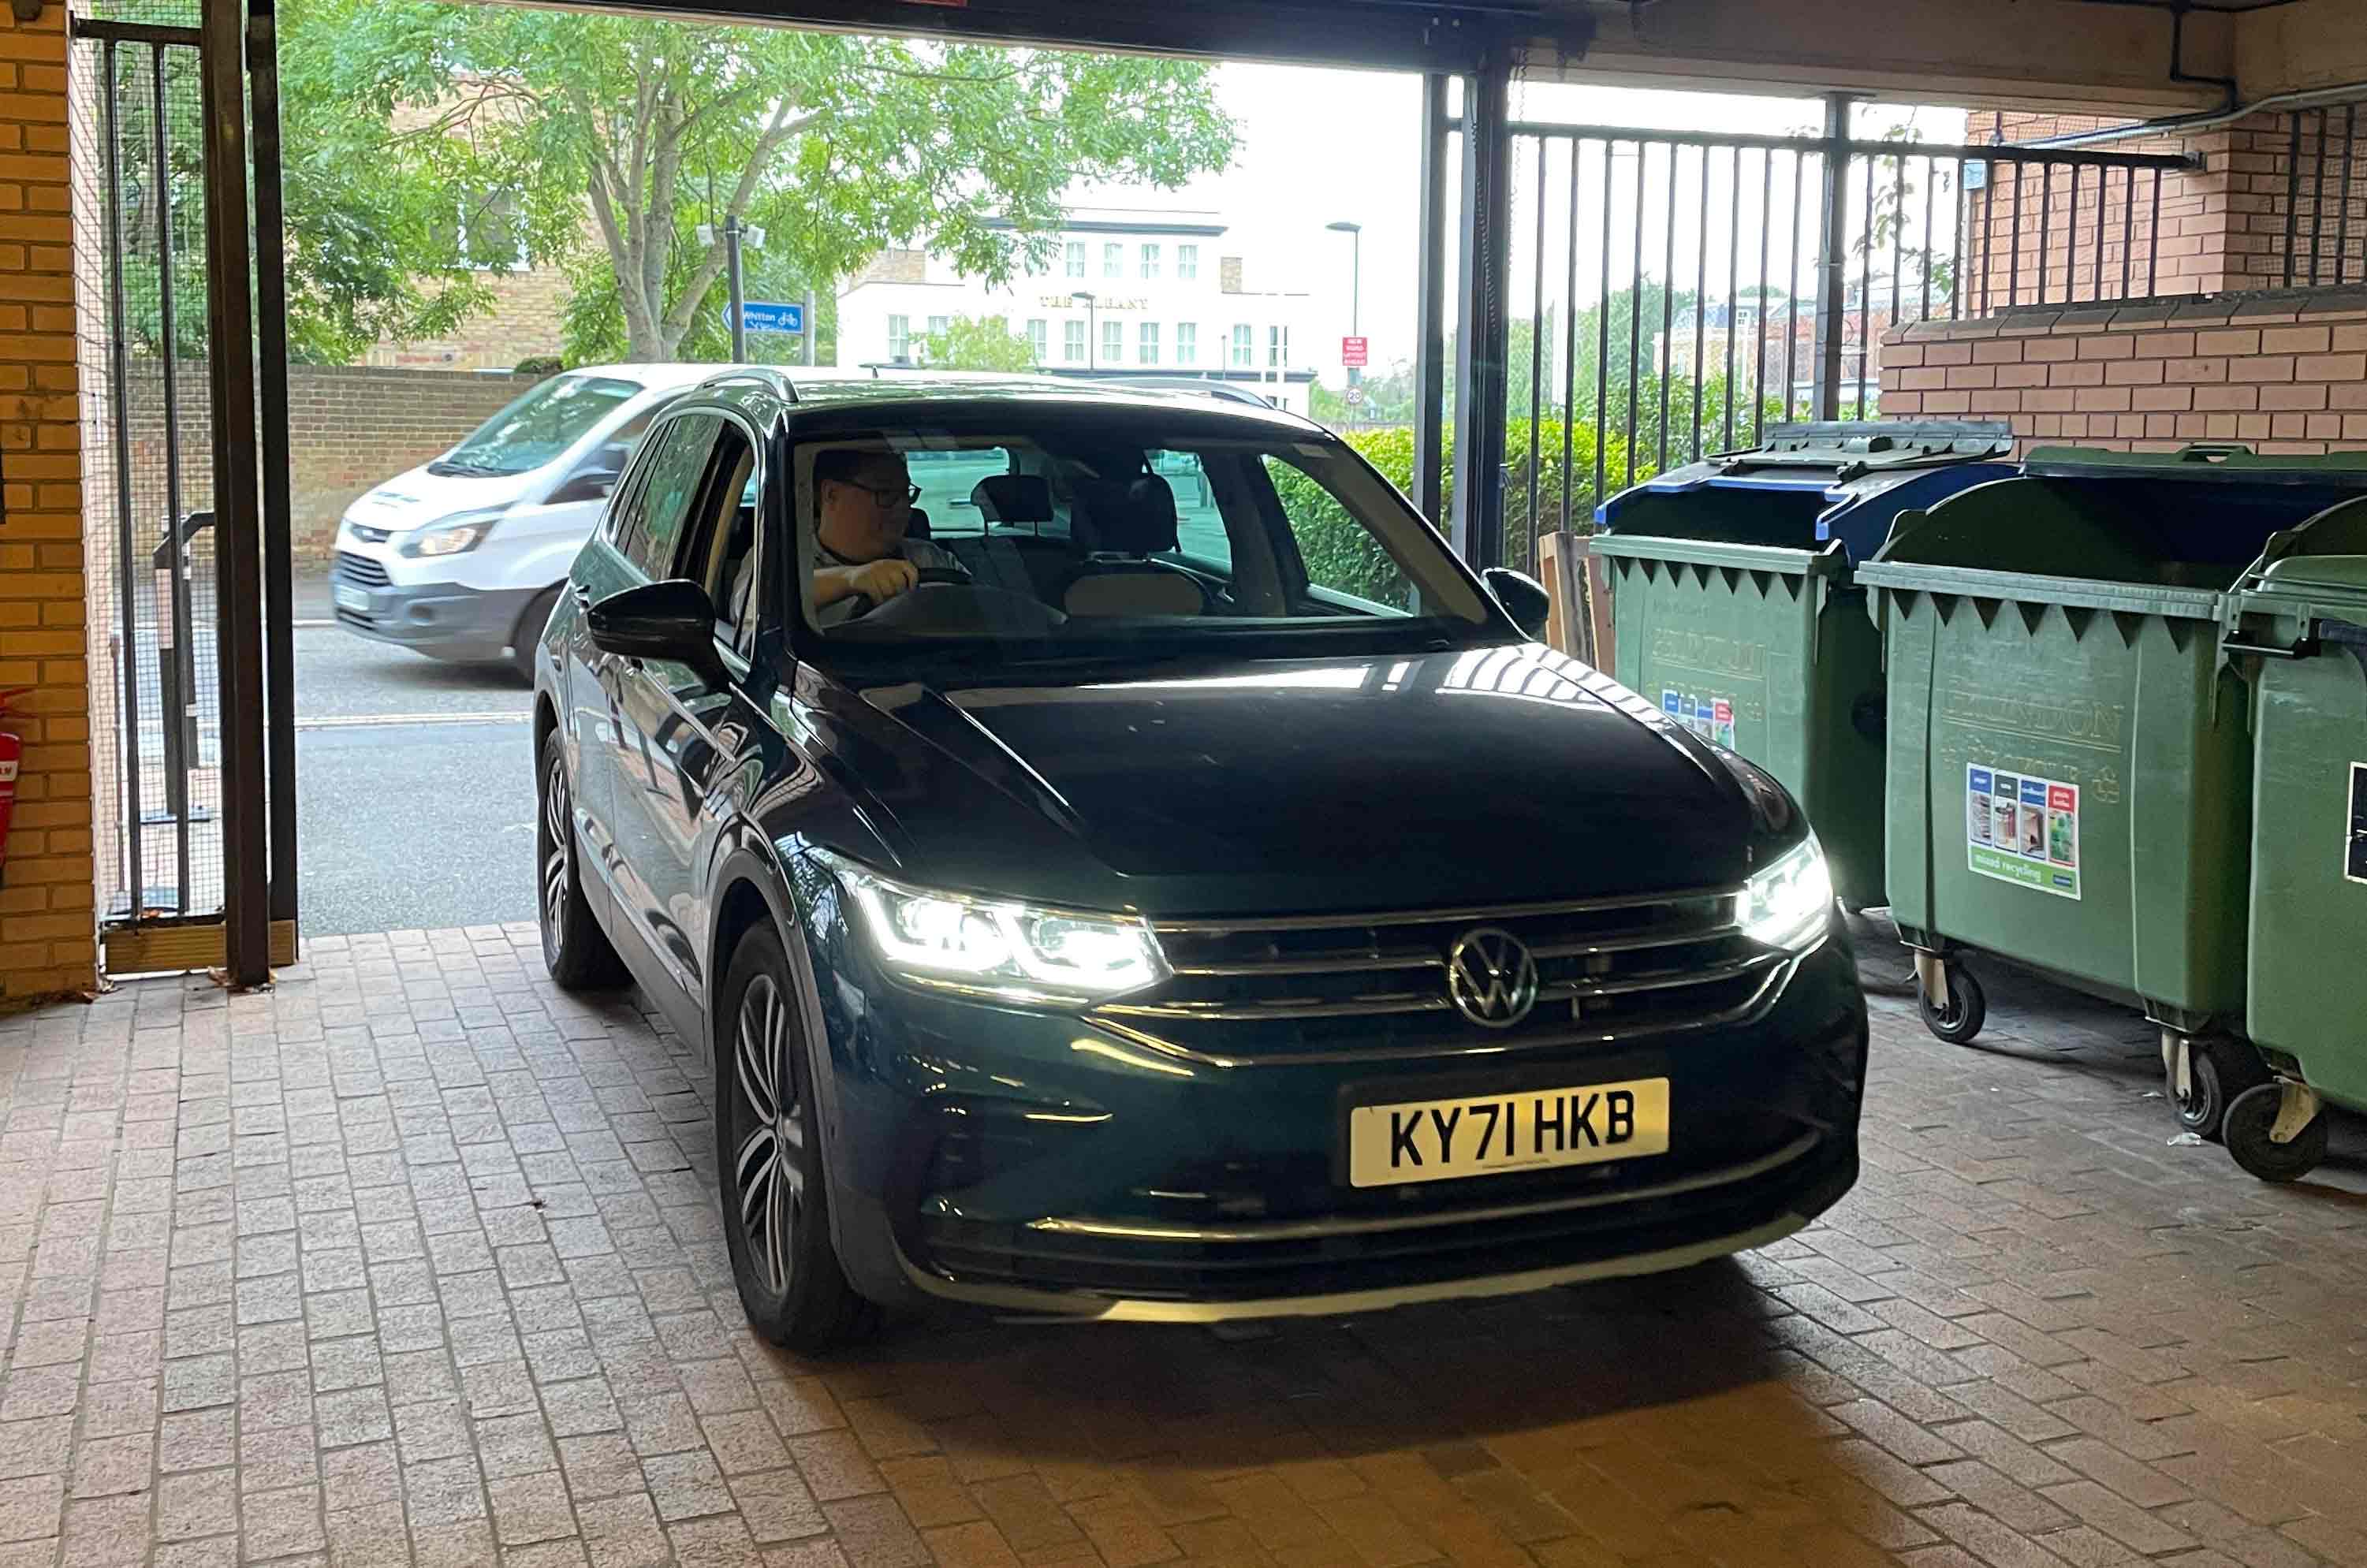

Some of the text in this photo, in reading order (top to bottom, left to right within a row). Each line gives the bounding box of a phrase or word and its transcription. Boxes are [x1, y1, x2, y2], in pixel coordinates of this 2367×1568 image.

[1039, 296, 1072, 308] THE
[1349, 392, 1361, 403] 20
[2001, 861, 2042, 883] recycling
[1391, 1089, 1635, 1168] KY71 HKB
